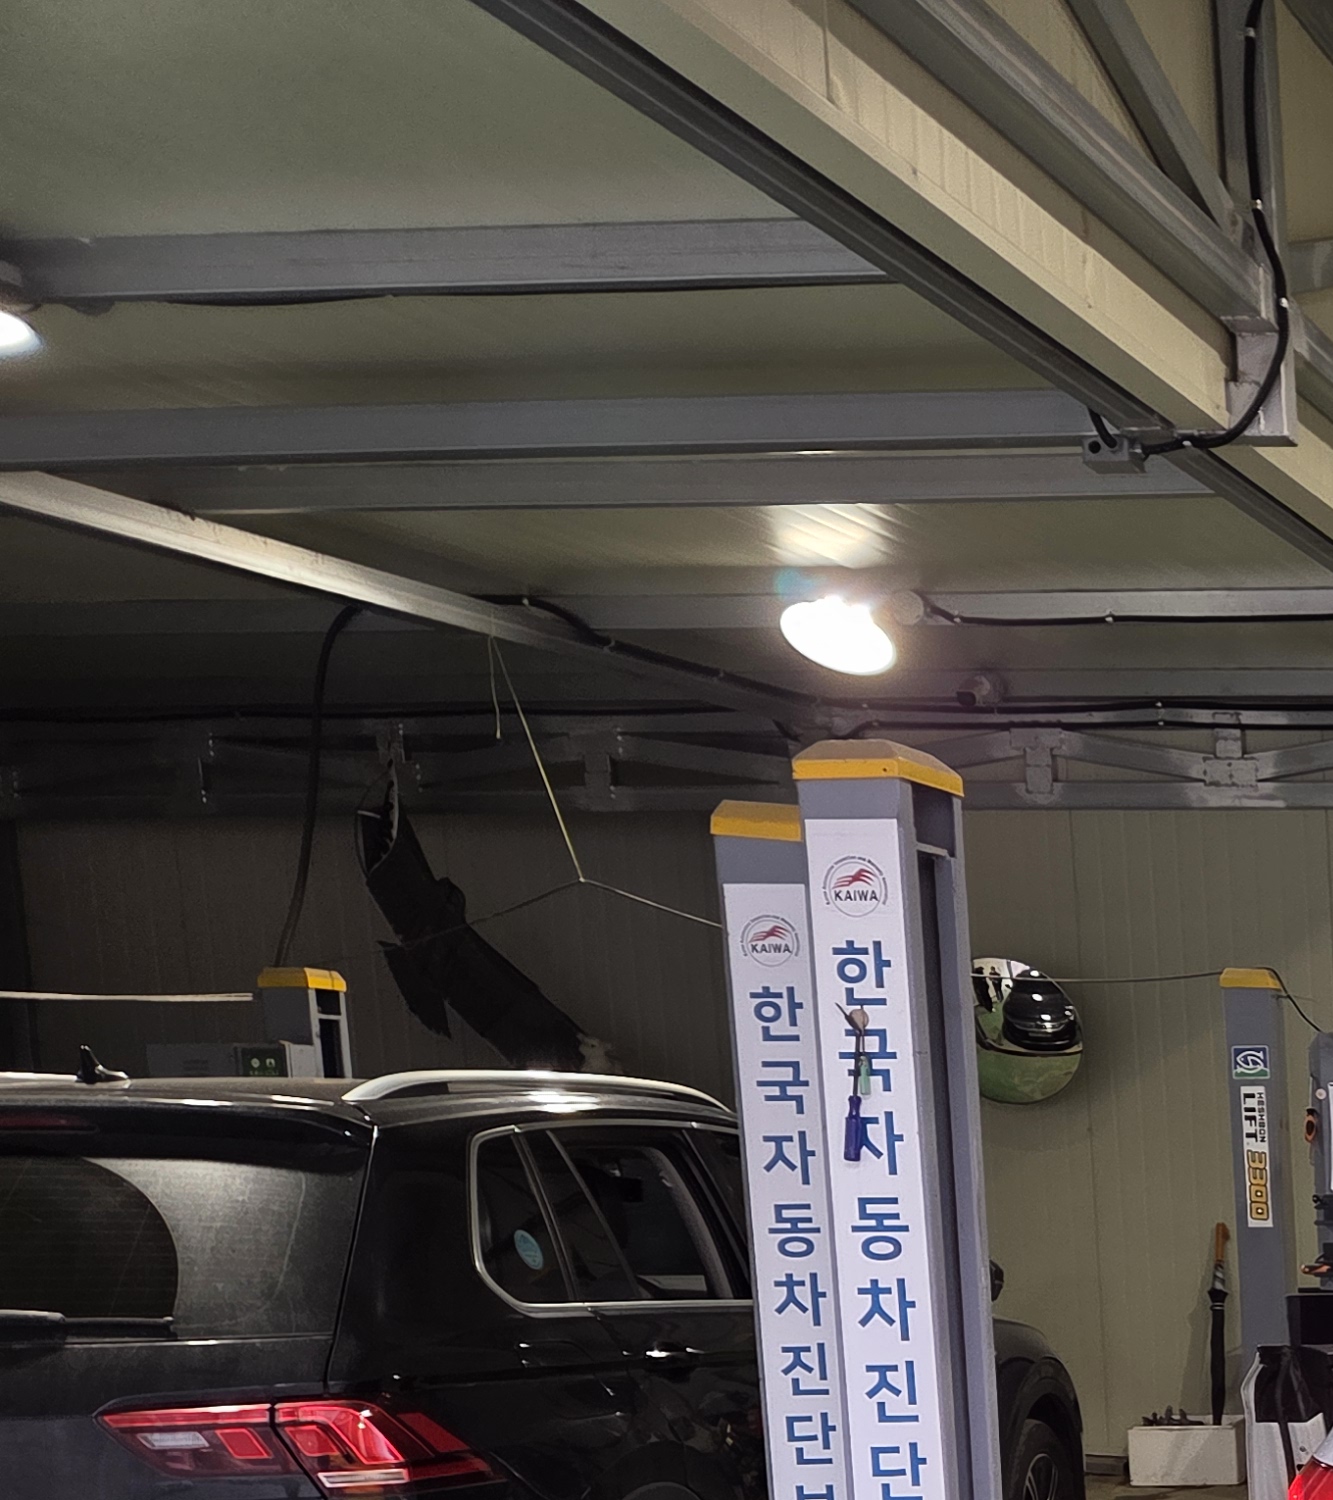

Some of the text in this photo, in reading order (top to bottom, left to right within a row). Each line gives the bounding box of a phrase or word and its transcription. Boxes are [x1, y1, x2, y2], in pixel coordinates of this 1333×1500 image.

[834, 889, 880, 902] KAIWA
[750, 943, 793, 954] KAIWA
[1256, 1091, 1266, 1143] HESHBON
[1242, 1092, 1270, 1221] LIFT 3300
